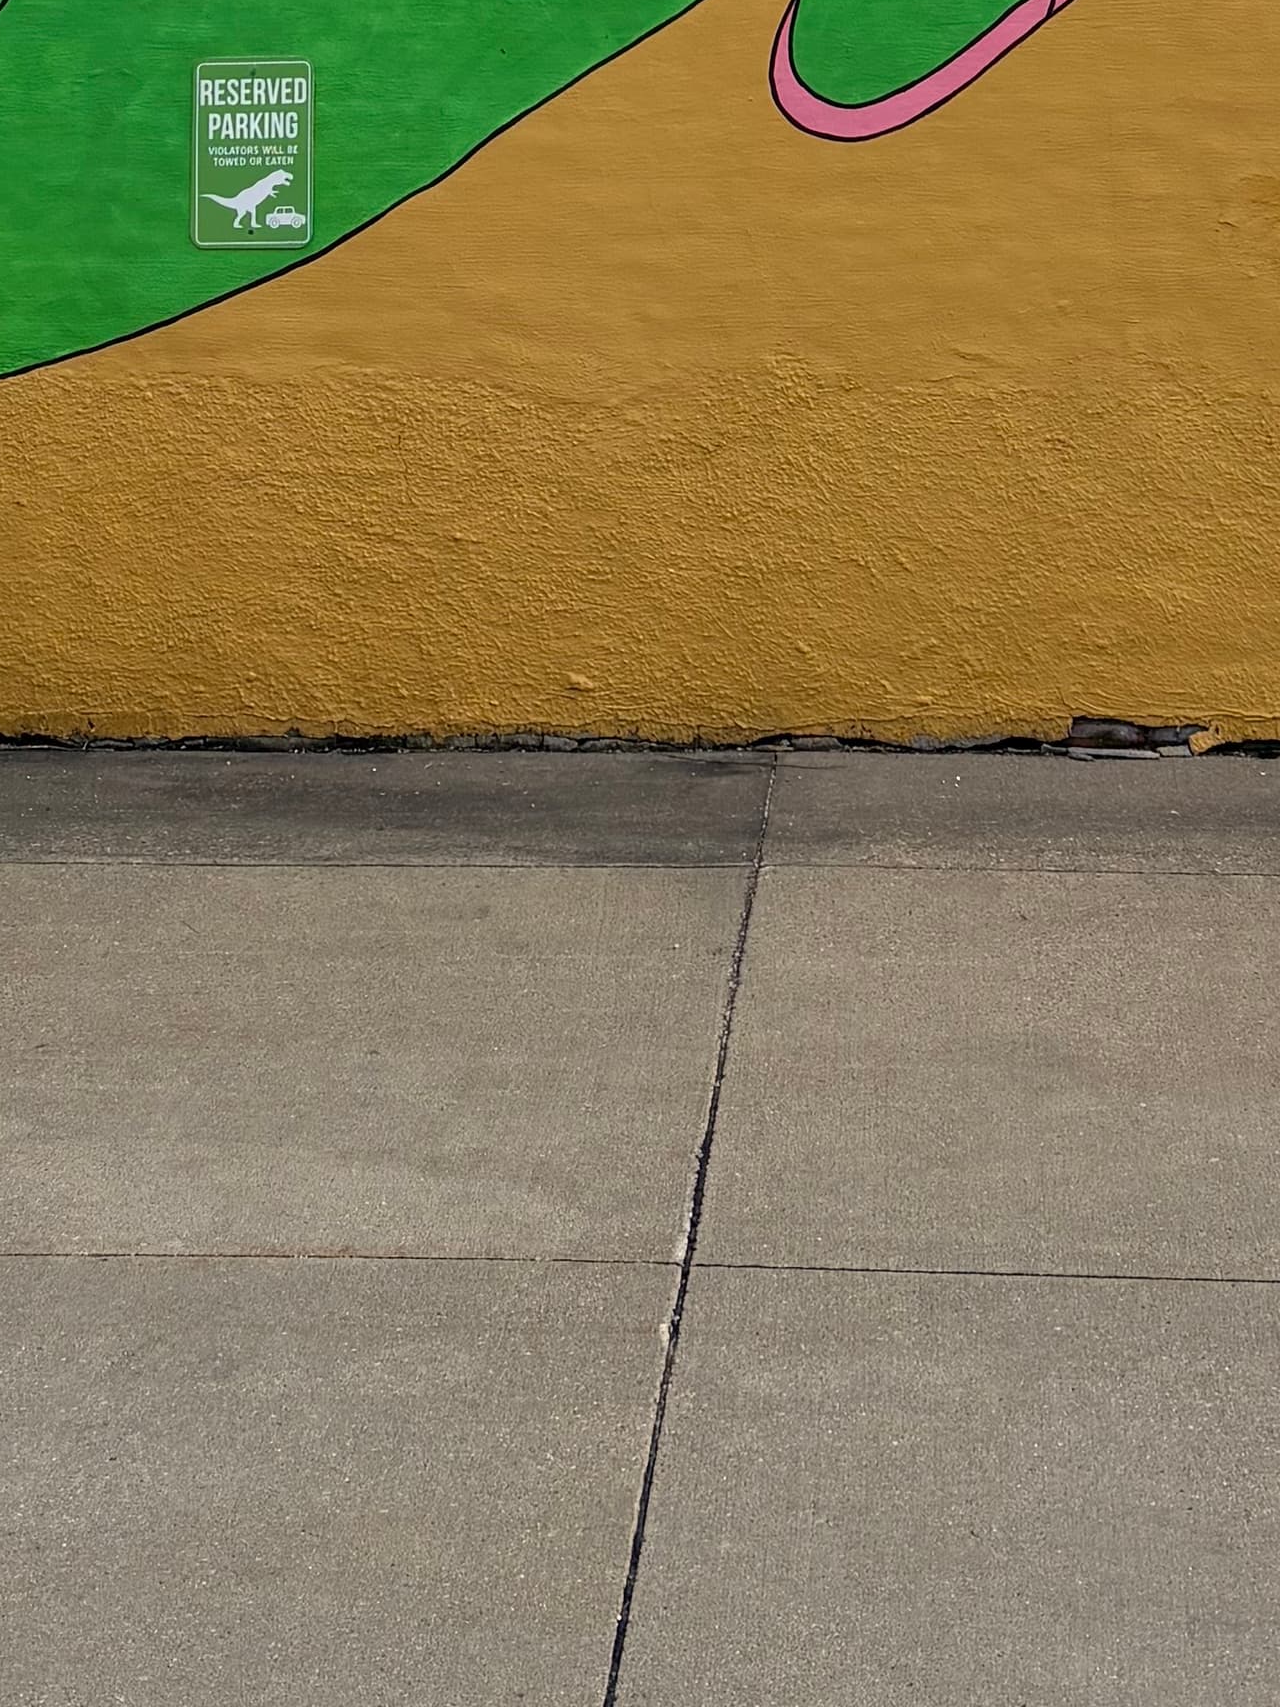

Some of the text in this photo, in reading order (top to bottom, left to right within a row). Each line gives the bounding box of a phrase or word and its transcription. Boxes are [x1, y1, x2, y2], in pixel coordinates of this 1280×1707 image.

[200, 77, 307, 106] RESERVED
[208, 111, 298, 140] PARKING
[208, 145, 298, 156] VIOLATORS WILL BE
[214, 155, 294, 167] TOWED OR EATEN
